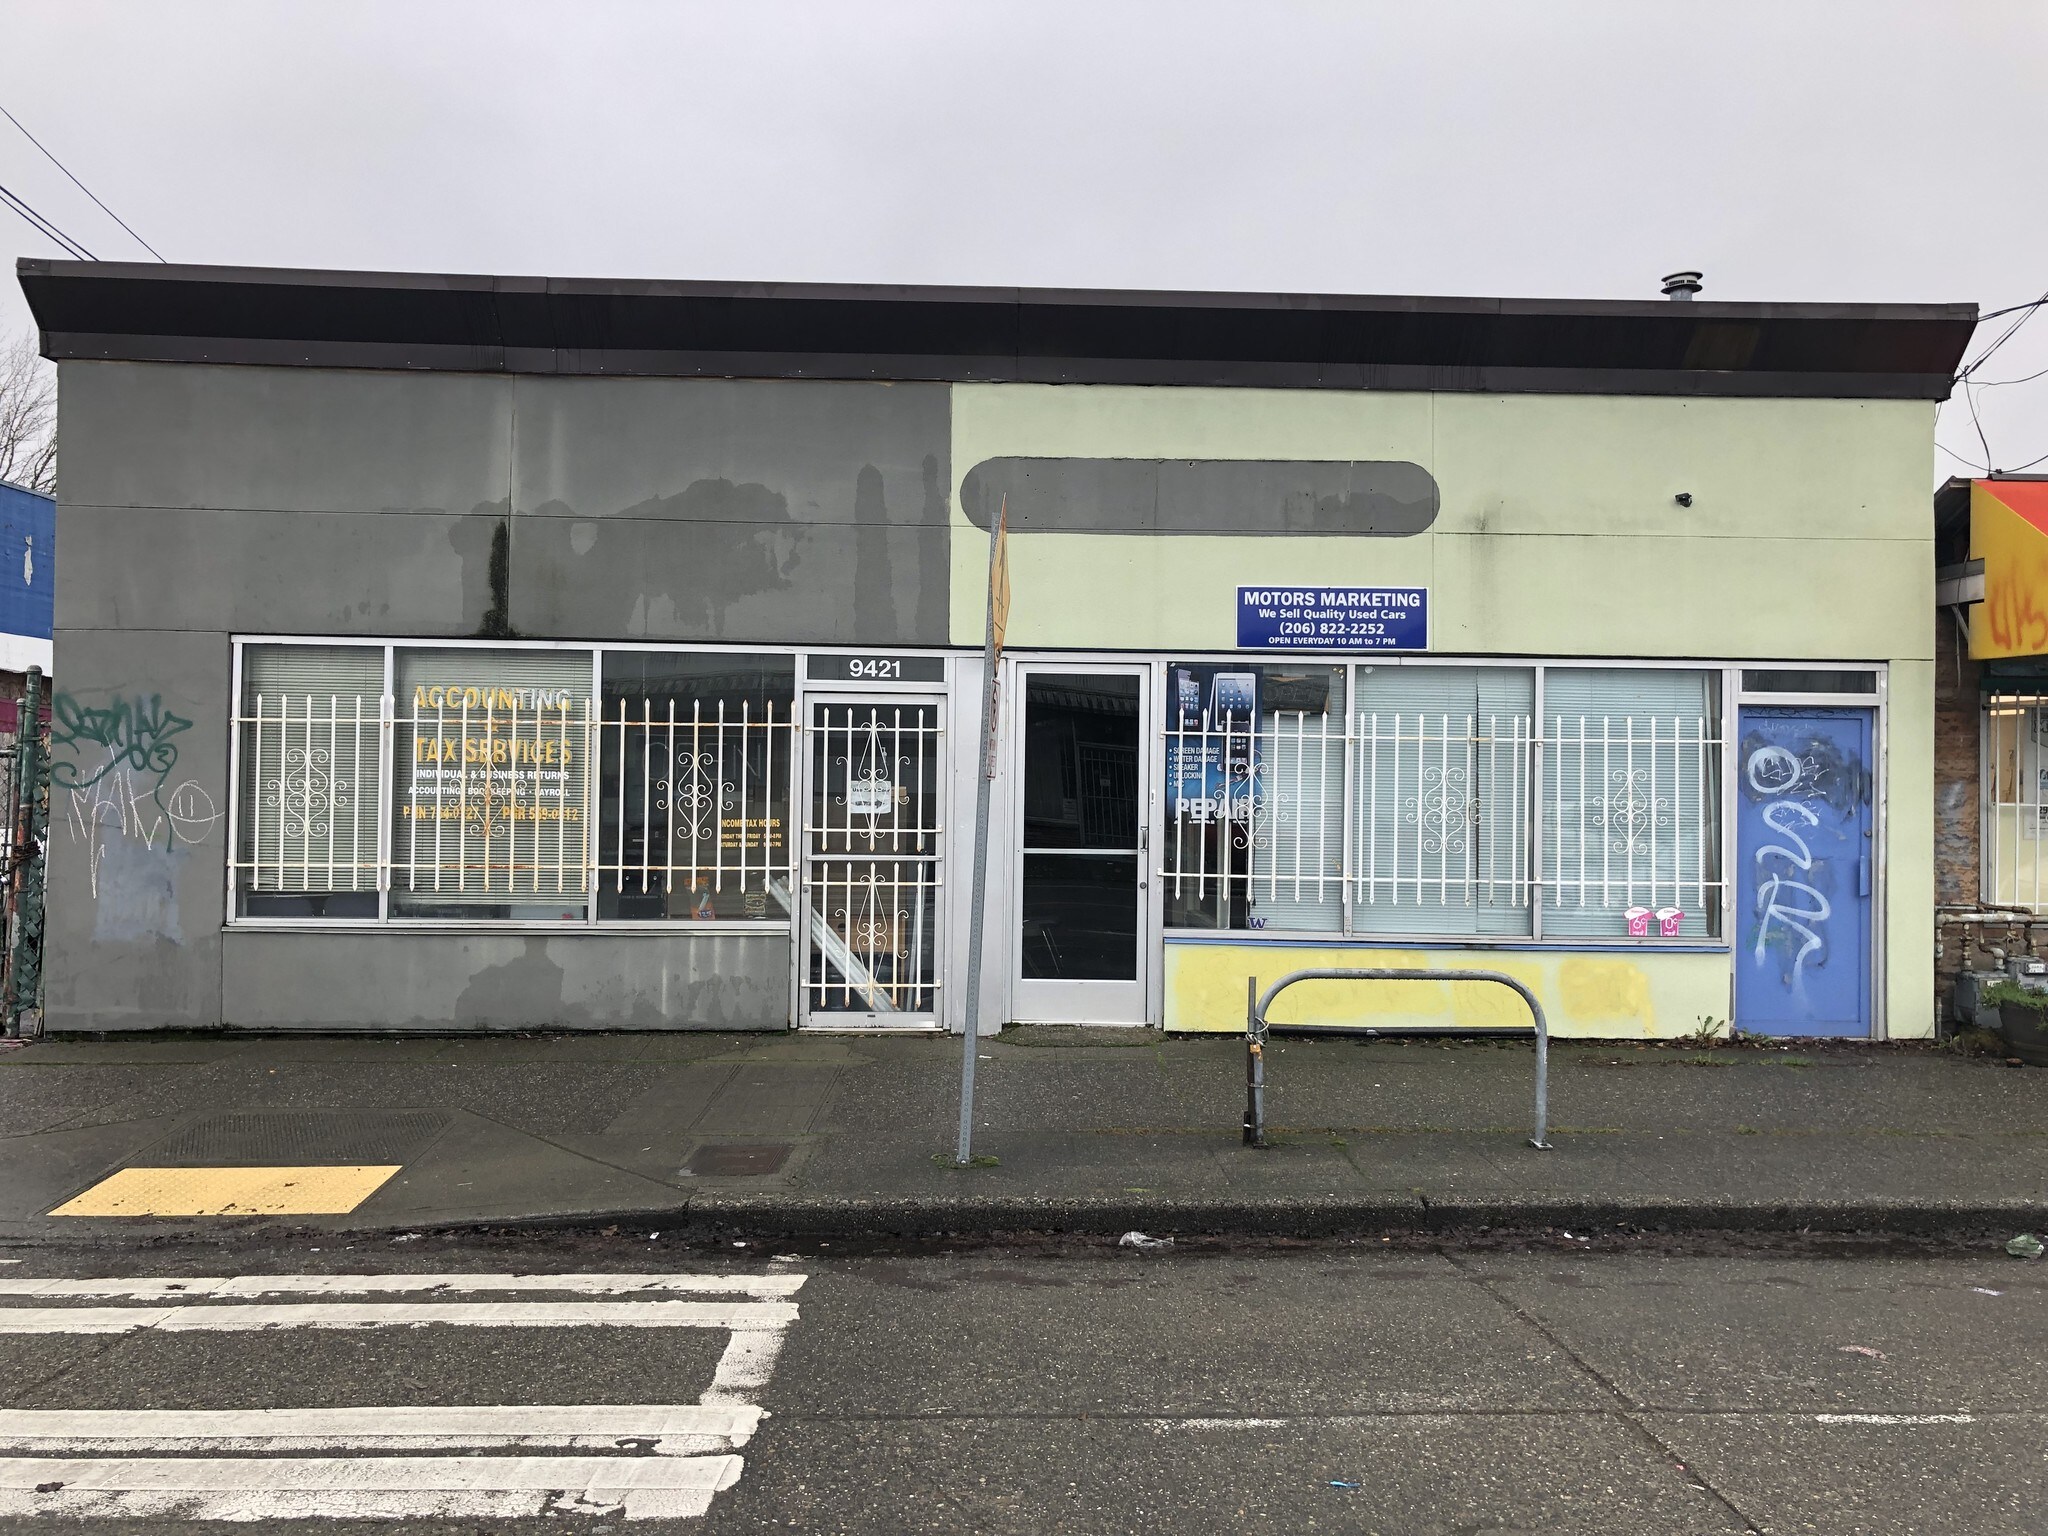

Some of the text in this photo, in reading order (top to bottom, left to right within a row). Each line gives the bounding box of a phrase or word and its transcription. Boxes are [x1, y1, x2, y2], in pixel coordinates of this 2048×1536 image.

[1244, 591, 1421, 607] MOTORS MARKETING
[1258, 608, 1407, 621] We Sell Quality Used Cars
[1279, 621, 1385, 636] (206) 822-2252
[1268, 636, 1396, 645] OPEN EVERYDAY 10 AM to 7 PM
[849, 659, 901, 678] 9421
[413, 686, 572, 711] ACCOUNTING
[416, 737, 572, 764] TAX SERVICES
[1173, 755, 1194, 763] WTER
[1173, 763, 1199, 771] SEAKER
[416, 769, 468, 779] INDIIDUA
[1173, 780, 1184, 788] MC
[408, 786, 571, 797] ACCOUTING BOOKEEPNG AYROL
[1174, 798, 1252, 820] REPAIR
[719, 818, 743, 828] NCOME
[745, 818, 758, 828] TAX
[1248, 917, 1268, 929] W
